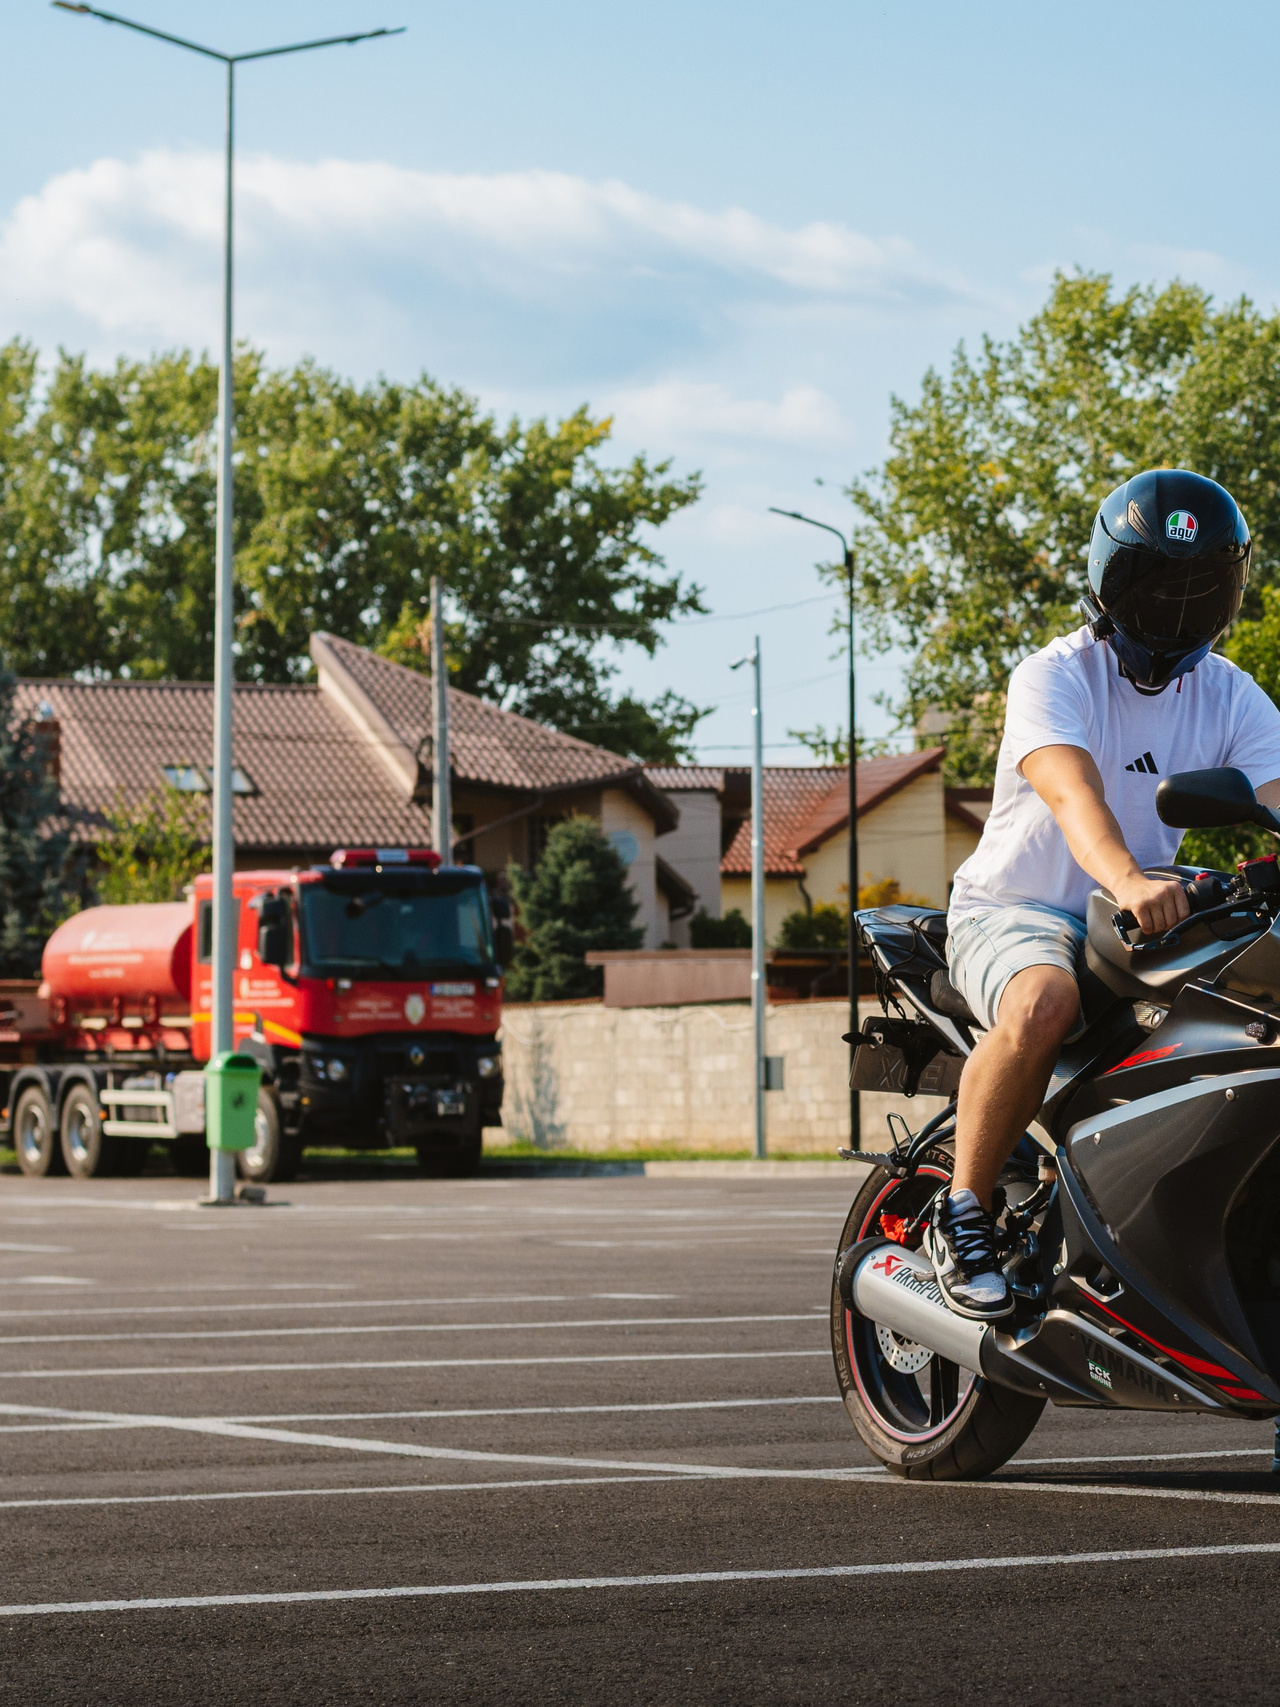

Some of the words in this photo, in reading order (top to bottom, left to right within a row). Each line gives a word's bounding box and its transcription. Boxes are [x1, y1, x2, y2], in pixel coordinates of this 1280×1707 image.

[893, 1267, 949, 1309] AKRAPOV
[833, 1279, 850, 1388] METZELE
[1089, 1362, 1111, 1381] FCK
